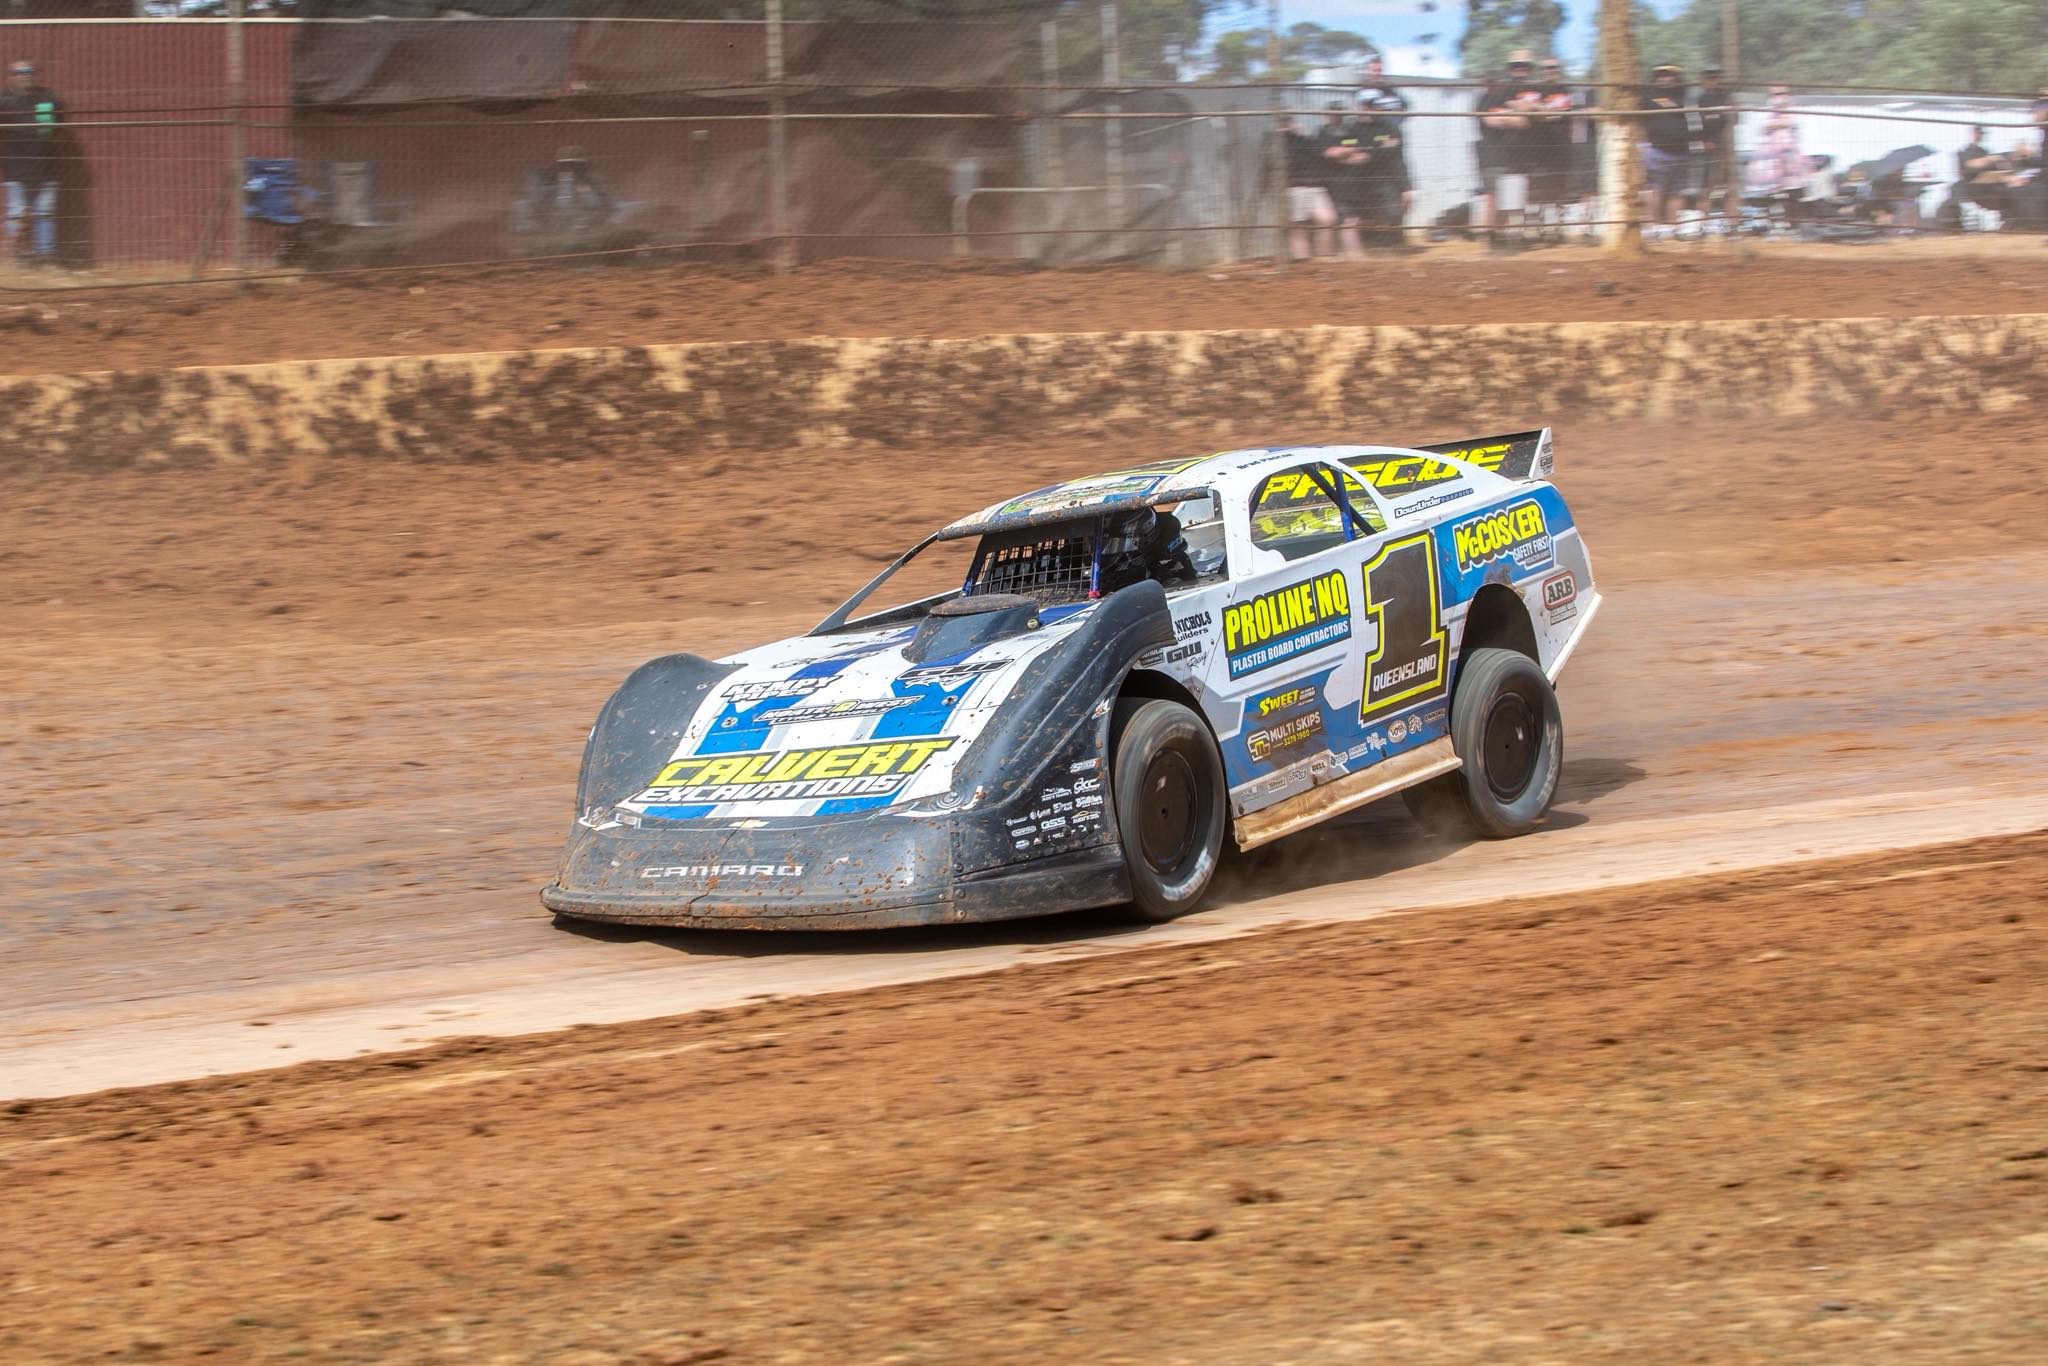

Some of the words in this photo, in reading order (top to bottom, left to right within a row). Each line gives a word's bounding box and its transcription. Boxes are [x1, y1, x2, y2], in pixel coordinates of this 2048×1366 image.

[1513, 541, 1533, 561] SAFETY
[1533, 536, 1550, 553] FIRST
[1547, 578, 1573, 603] ARB
[1174, 611, 1212, 634] NICHOLS
[1225, 584, 1316, 652] PROLINE
[1315, 572, 1349, 618] NQ
[1363, 533, 1446, 716] 1
[1177, 627, 1208, 642] uilders
[1232, 650, 1267, 673] PLASTER
[1267, 640, 1294, 661] BOARD
[1295, 621, 1349, 650] CONTRACTORS
[723, 675, 843, 697] KEMPY
[1373, 654, 1437, 692] QUEENSLAND
[1260, 690, 1299, 716] SWEET
[1270, 721, 1295, 742] MULTI
[1296, 711, 1321, 732] SKIPS
[649, 740, 951, 787] CALVERT
[1311, 761, 1326, 772] BELL
[641, 774, 903, 801] EXCAVATIONS
[640, 864, 804, 879] CAMARO
